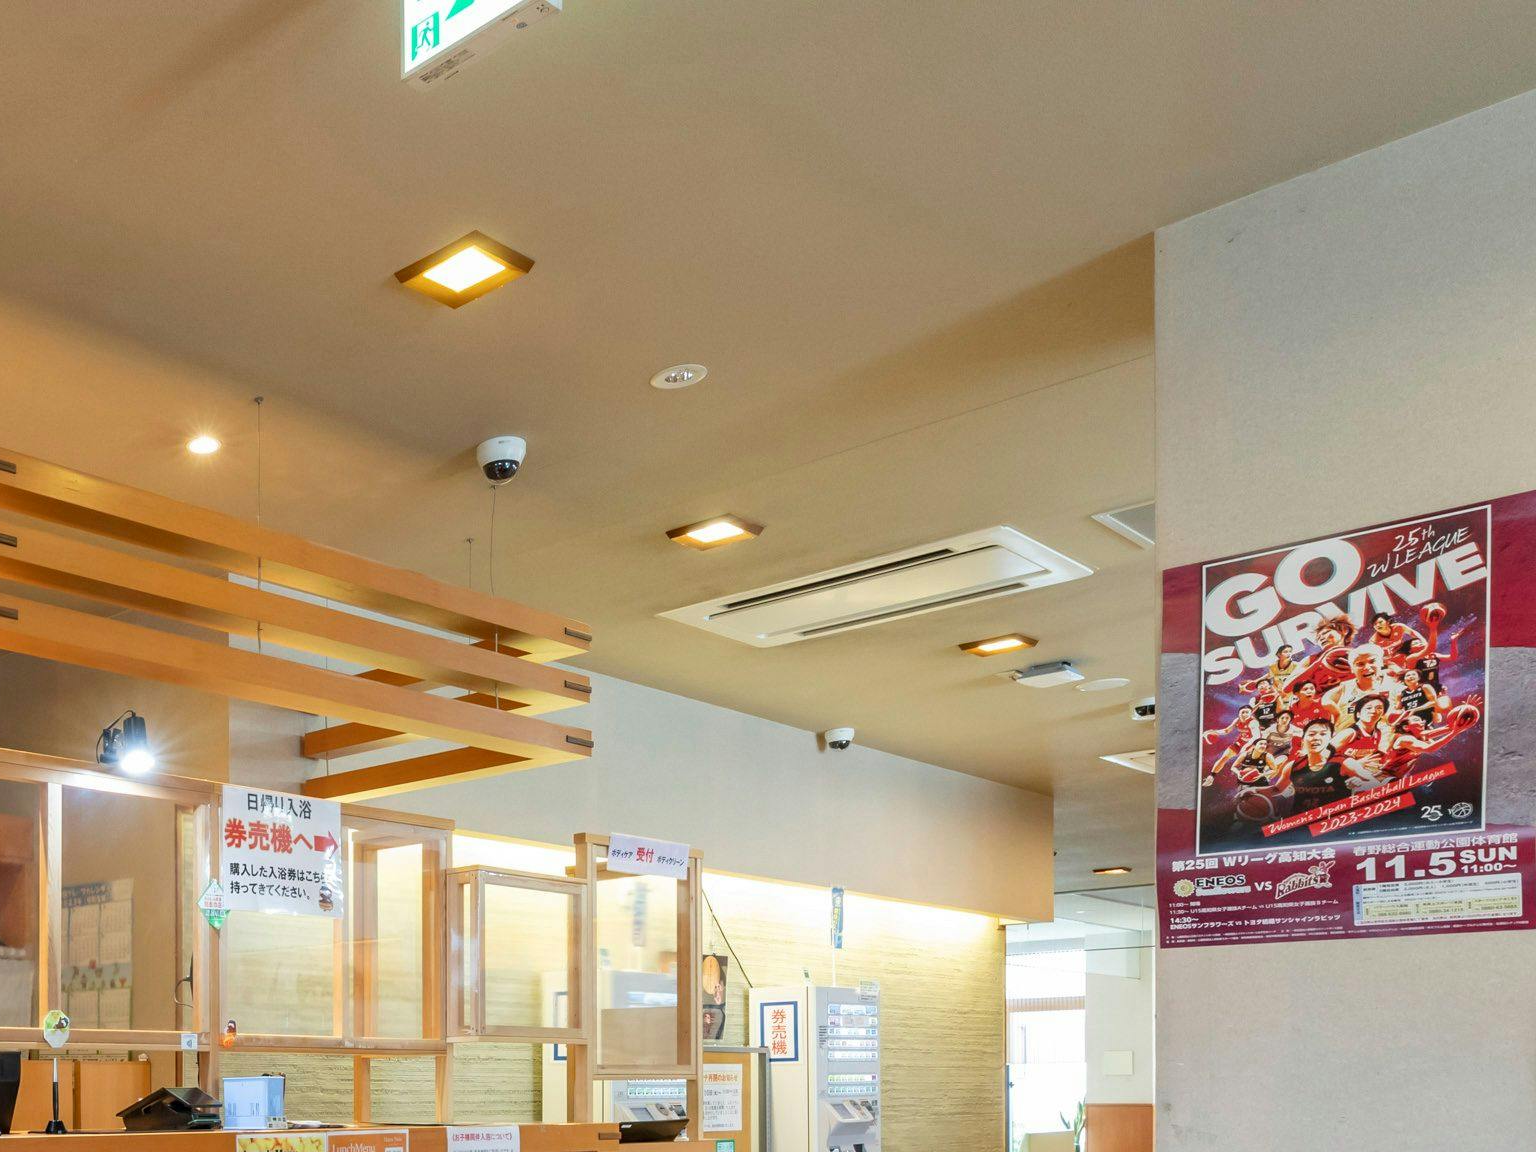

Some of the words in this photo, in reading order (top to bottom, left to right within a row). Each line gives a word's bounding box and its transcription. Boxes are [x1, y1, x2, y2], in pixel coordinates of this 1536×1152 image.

[1394, 524, 1436, 552] 25th
[1394, 526, 1473, 569] LEAGUE
[1204, 537, 1363, 637] GO
[1204, 541, 1488, 686] SURVIVE
[246, 792, 313, 820] 日帰り入浴
[1267, 814, 1315, 834] Women's
[1316, 801, 1348, 820] Japan
[1349, 777, 1407, 808] Basketball
[1408, 768, 1446, 789] League
[1319, 796, 1401, 834] 2023-2024
[224, 818, 314, 855] 券売機へ
[1353, 832, 1519, 857] 春野総合運動公園体育館
[636, 847, 655, 863] 受付
[1171, 857, 1219, 873] 第25回
[1222, 847, 1336, 868] Wリーグ高知大会
[1355, 850, 1457, 882] 11.5
[1459, 846, 1519, 864] SUN
[230, 880, 311, 900] 持ってきてください。
[1195, 874, 1247, 888] ENEOS
[1277, 872, 1323, 898] Rabbits
[771, 1008, 788, 1055] 券売機
